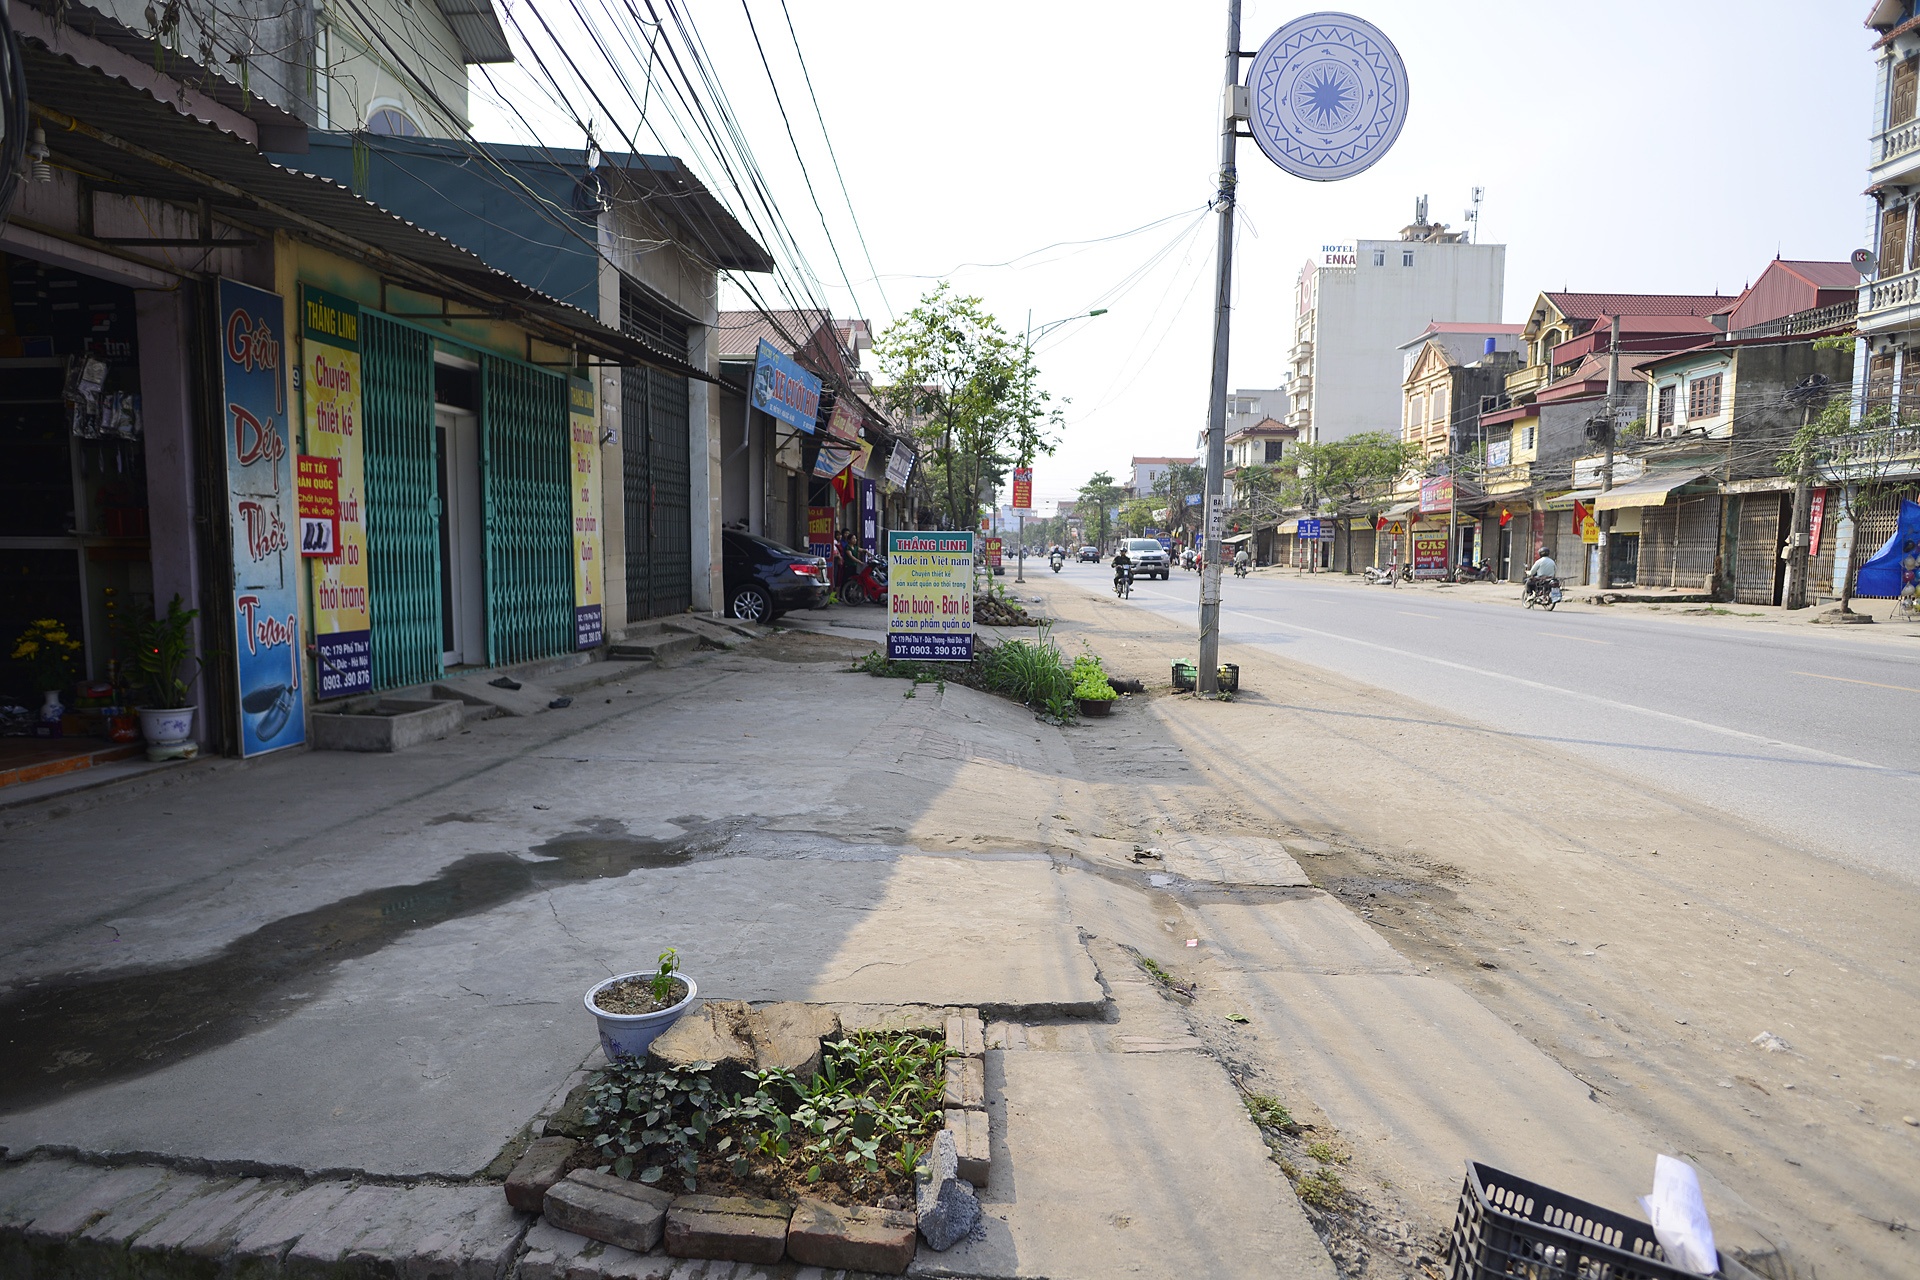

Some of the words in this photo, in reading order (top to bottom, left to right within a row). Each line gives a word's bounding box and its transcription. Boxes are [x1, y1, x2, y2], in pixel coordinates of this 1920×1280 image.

[1322, 245, 1355, 253] HOTEL
[1326, 254, 1356, 265] ENKA
[338, 311, 357, 342] LINH
[315, 354, 352, 398] Chuyên
[772, 368, 786, 402] XE
[317, 398, 340, 435] thiết
[341, 401, 354, 437] kế
[229, 403, 286, 495] Dép
[809, 517, 832, 534] TERNET
[348, 535, 359, 566] áo
[808, 543, 832, 559] ame
[896, 536, 937, 550] THẮNG
[939, 539, 967, 551] LINH
[1417, 541, 1446, 550] GAS
[893, 555, 918, 566] Made
[920, 555, 928, 565] in
[931, 555, 948, 568] Việt
[951, 557, 970, 566] nam
[911, 569, 930, 578] Chuyên
[931, 569, 944, 578] thiết
[952, 580, 967, 590] trang
[320, 579, 339, 610] thời
[340, 583, 365, 615] trang
[893, 593, 910, 614] Bán
[912, 594, 935, 614] buôn
[942, 594, 959, 614] Bán
[961, 592, 970, 615] lẻ
[891, 617, 904, 628] các
[905, 616, 918, 628] sản
[920, 615, 940, 630] phẩm
[942, 616, 960, 630] quần
[961, 618, 971, 629] áo
[238, 595, 298, 690] Trang
[333, 644, 343, 655] 179
[343, 641, 354, 654] Phố
[364, 641, 369, 651] Y
[895, 645, 909, 655] ĐT:
[910, 645, 933, 655] 0903.
[934, 646, 950, 655] 390
[951, 646, 967, 656] 876
[323, 674, 343, 691] 0903.
[343, 671, 357, 688] 390
[357, 669, 370, 686] 876
